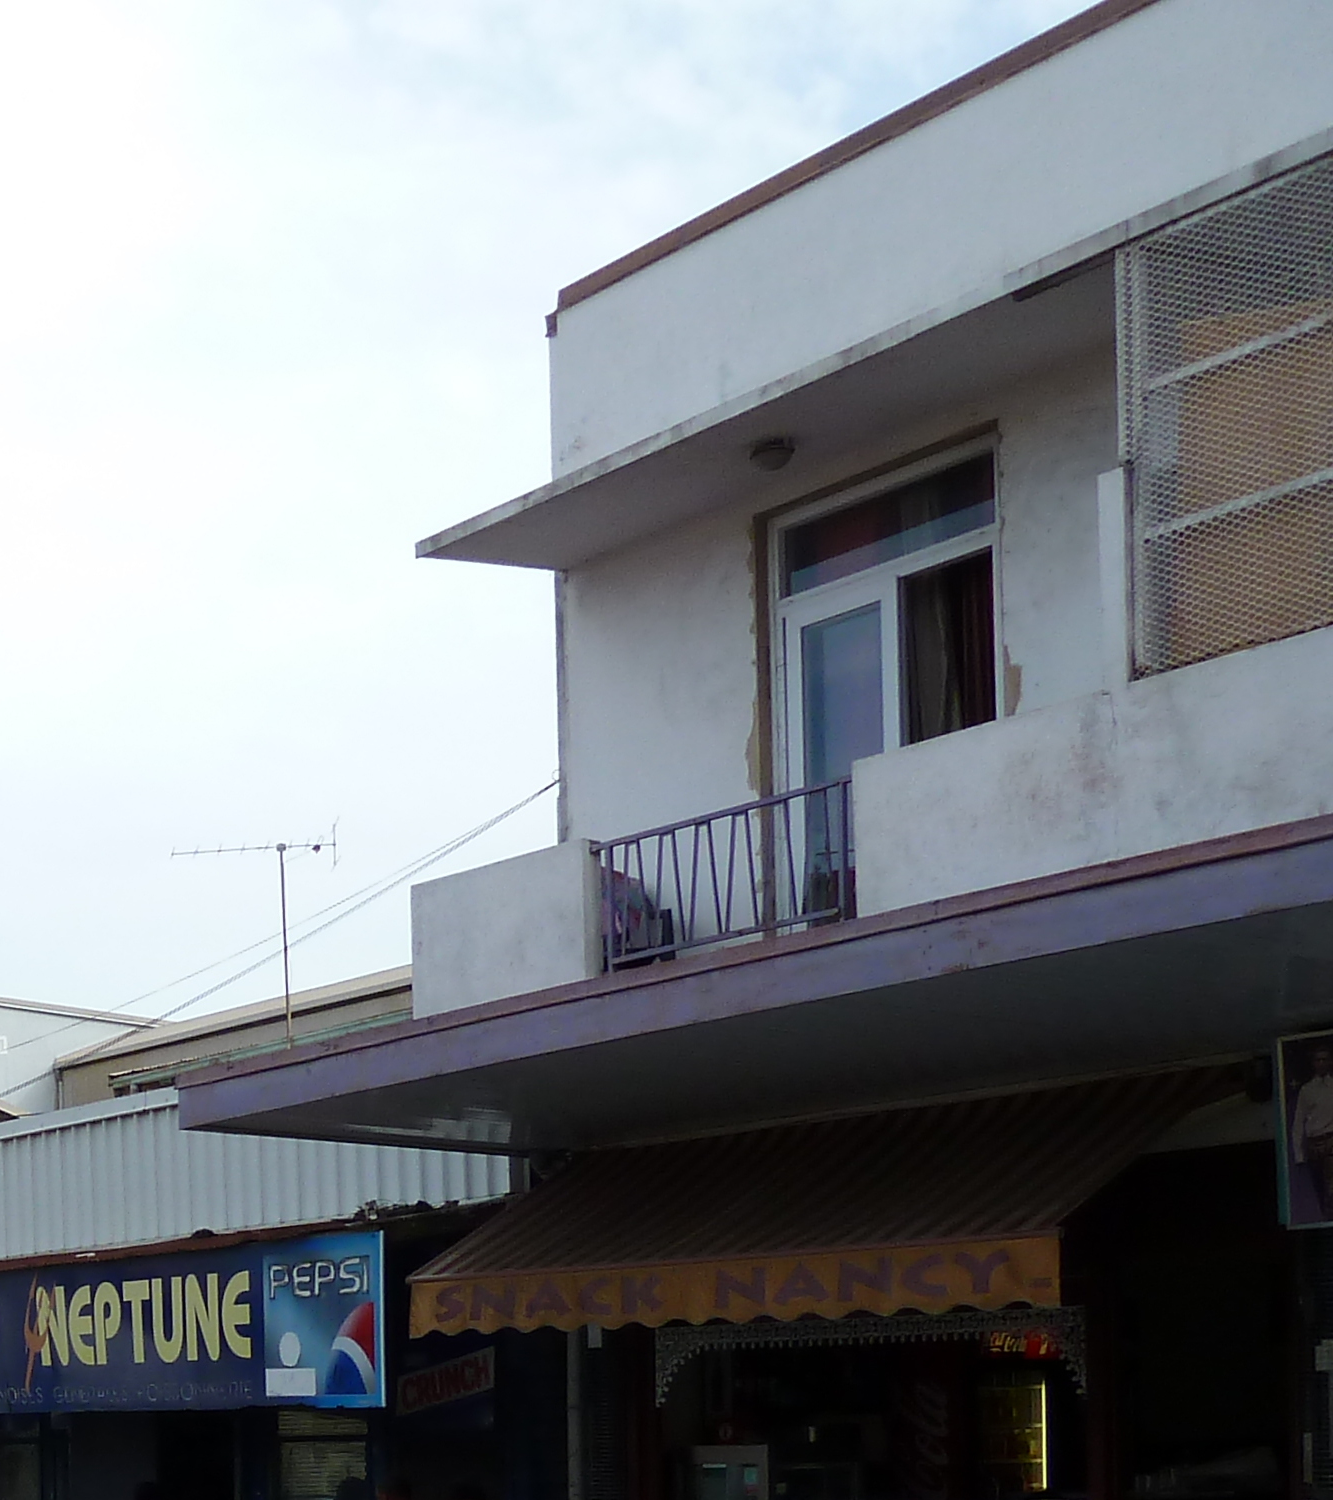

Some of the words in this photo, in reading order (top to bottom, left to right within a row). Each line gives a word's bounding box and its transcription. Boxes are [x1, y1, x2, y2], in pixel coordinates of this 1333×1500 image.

[269, 1255, 369, 1299] PEPSI
[435, 1274, 663, 1324] SNACK
[713, 1250, 1011, 1310] NANCY
[36, 1265, 251, 1368] NEPTUNE
[402, 1355, 492, 1409] CRUNCH
